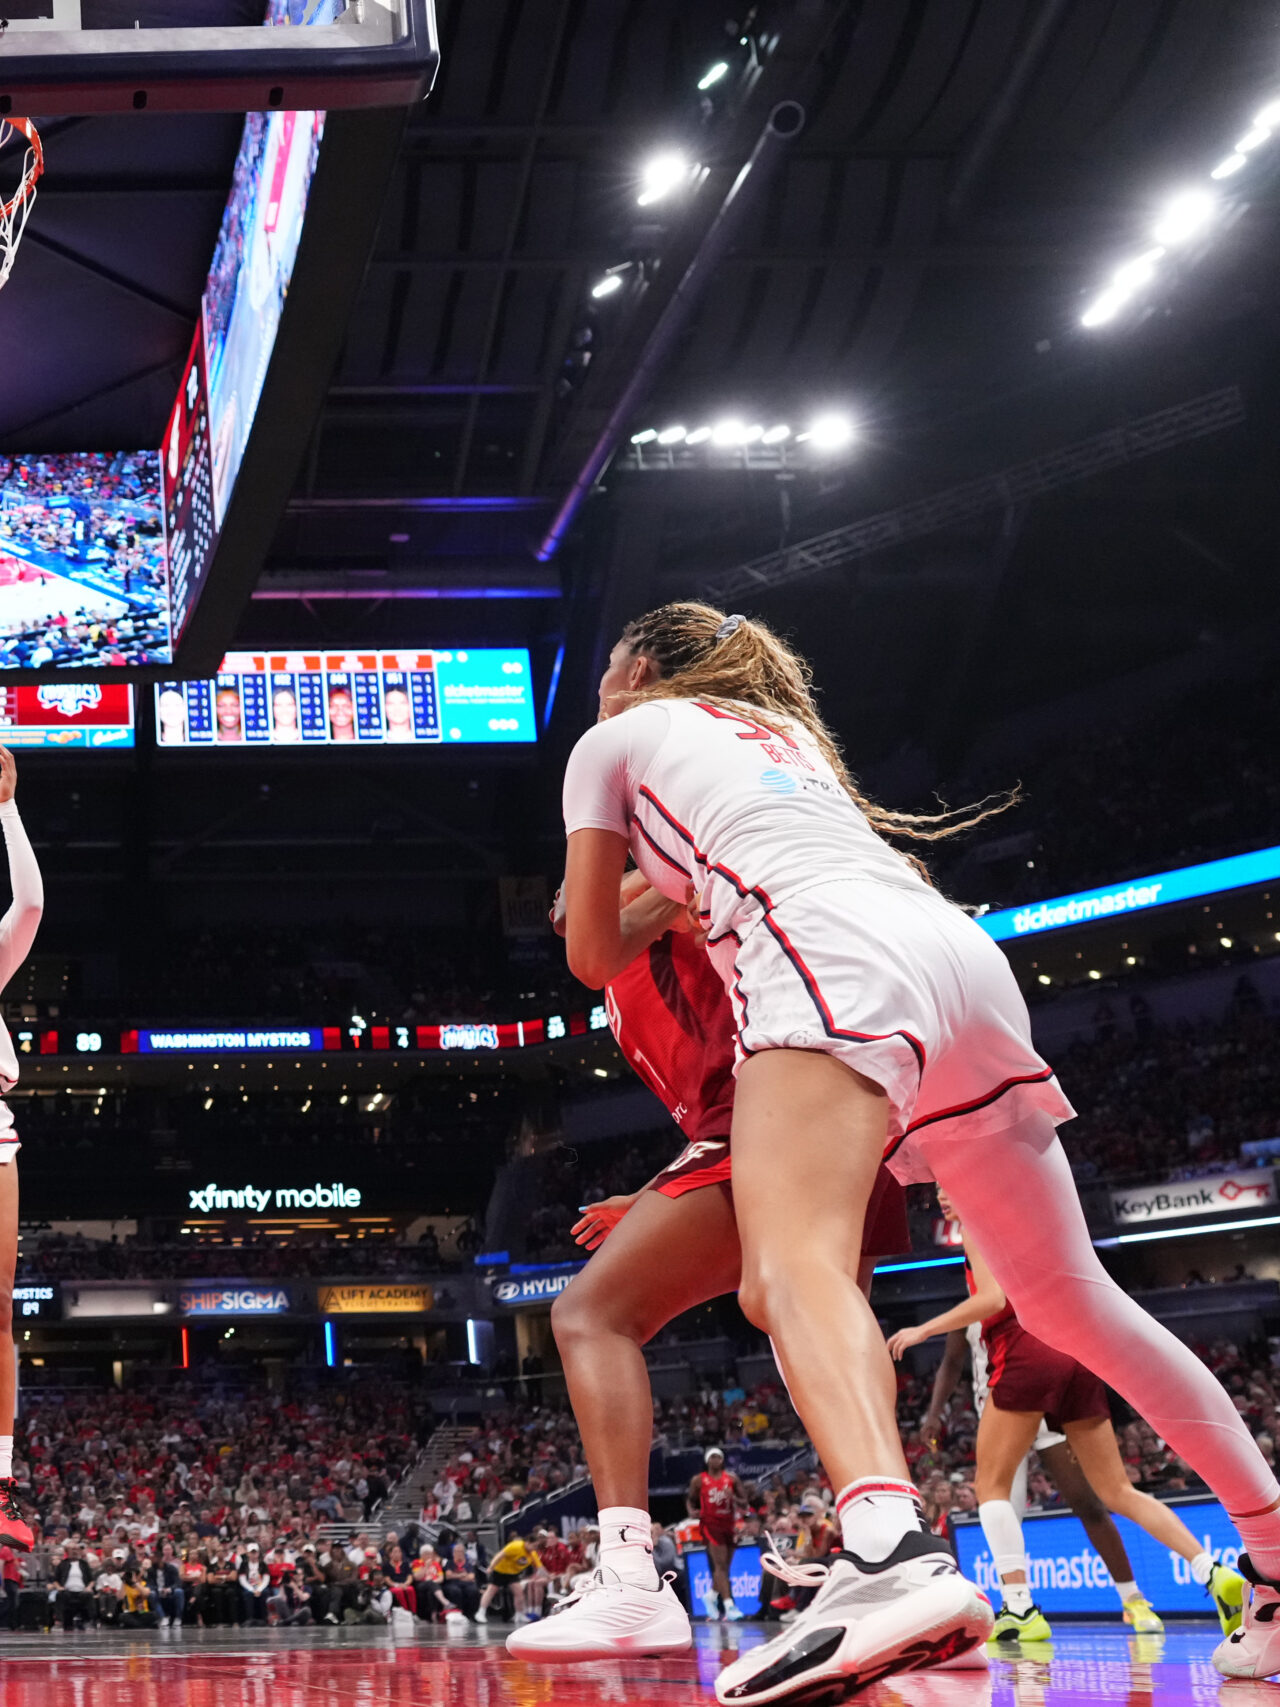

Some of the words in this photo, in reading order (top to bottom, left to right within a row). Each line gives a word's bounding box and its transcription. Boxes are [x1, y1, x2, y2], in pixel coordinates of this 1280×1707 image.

[760, 743, 817, 772] BETTS
[1012, 883, 1163, 934] ticketmaster
[76, 1033, 102, 1052] 89
[150, 1033, 246, 1048] WASHINGTON
[247, 1032, 311, 1047] MYSTICS
[397, 1034, 409, 1048] 4
[189, 1184, 272, 1213] xfinity
[275, 1183, 361, 1208] mobile
[1115, 1189, 1214, 1218] KeyBank
[368, 1287, 428, 1300] ACADEMY
[522, 1273, 577, 1296] HYUN
[180, 1291, 289, 1310] SHIPSIGMA
